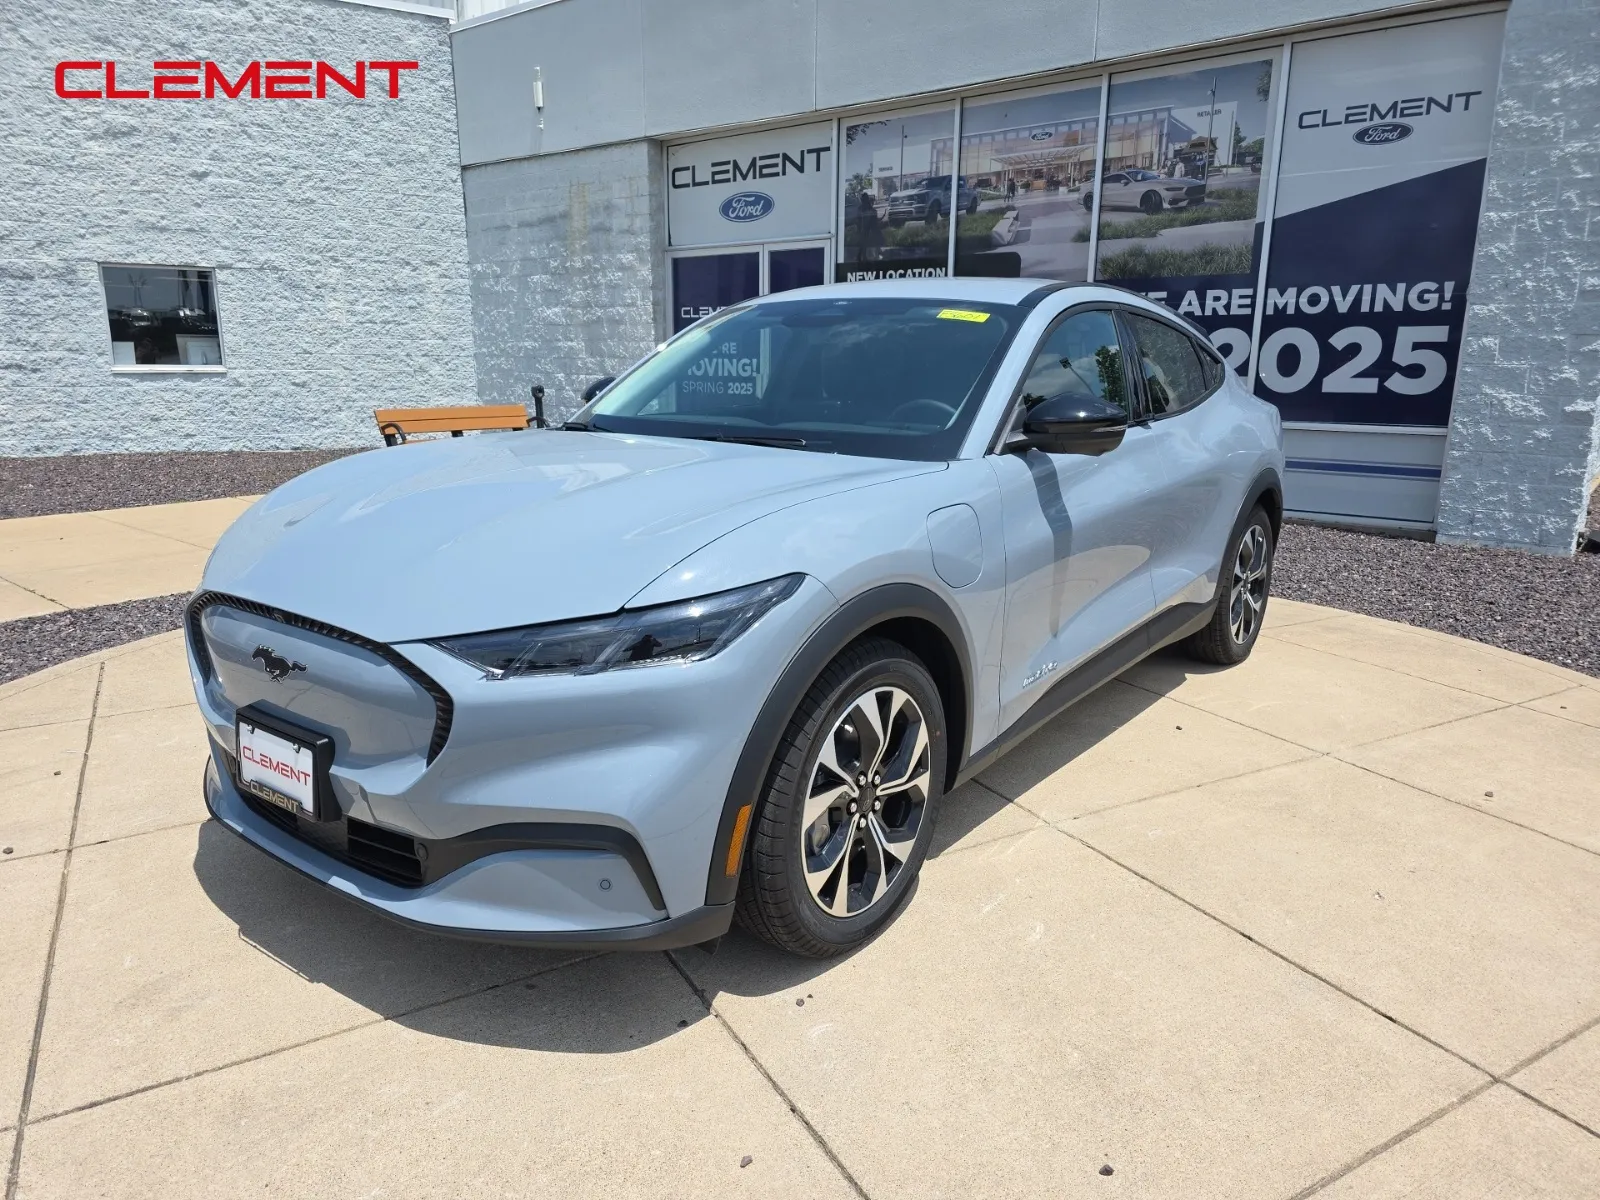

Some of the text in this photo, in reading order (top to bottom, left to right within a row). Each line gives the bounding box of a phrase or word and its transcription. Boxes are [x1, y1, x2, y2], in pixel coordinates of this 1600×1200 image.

[1196, 109, 1222, 118] RETALER
[1298, 90, 1482, 130] CLEMENT
[1362, 125, 1403, 143] Ford
[671, 146, 831, 190] CLEMENT
[727, 195, 766, 219] Ford
[847, 267, 946, 283] NEW LOCATION
[1177, 287, 1254, 316] ARE
[1265, 281, 1456, 316] MOVING!
[681, 306, 728, 318] CLEM
[687, 358, 758, 377] OVING!
[1208, 325, 1450, 396] 2025
[682, 381, 754, 395] SPRING 2025
[242, 745, 311, 787] CLEMENT
[250, 780, 299, 813] CLEMENT
